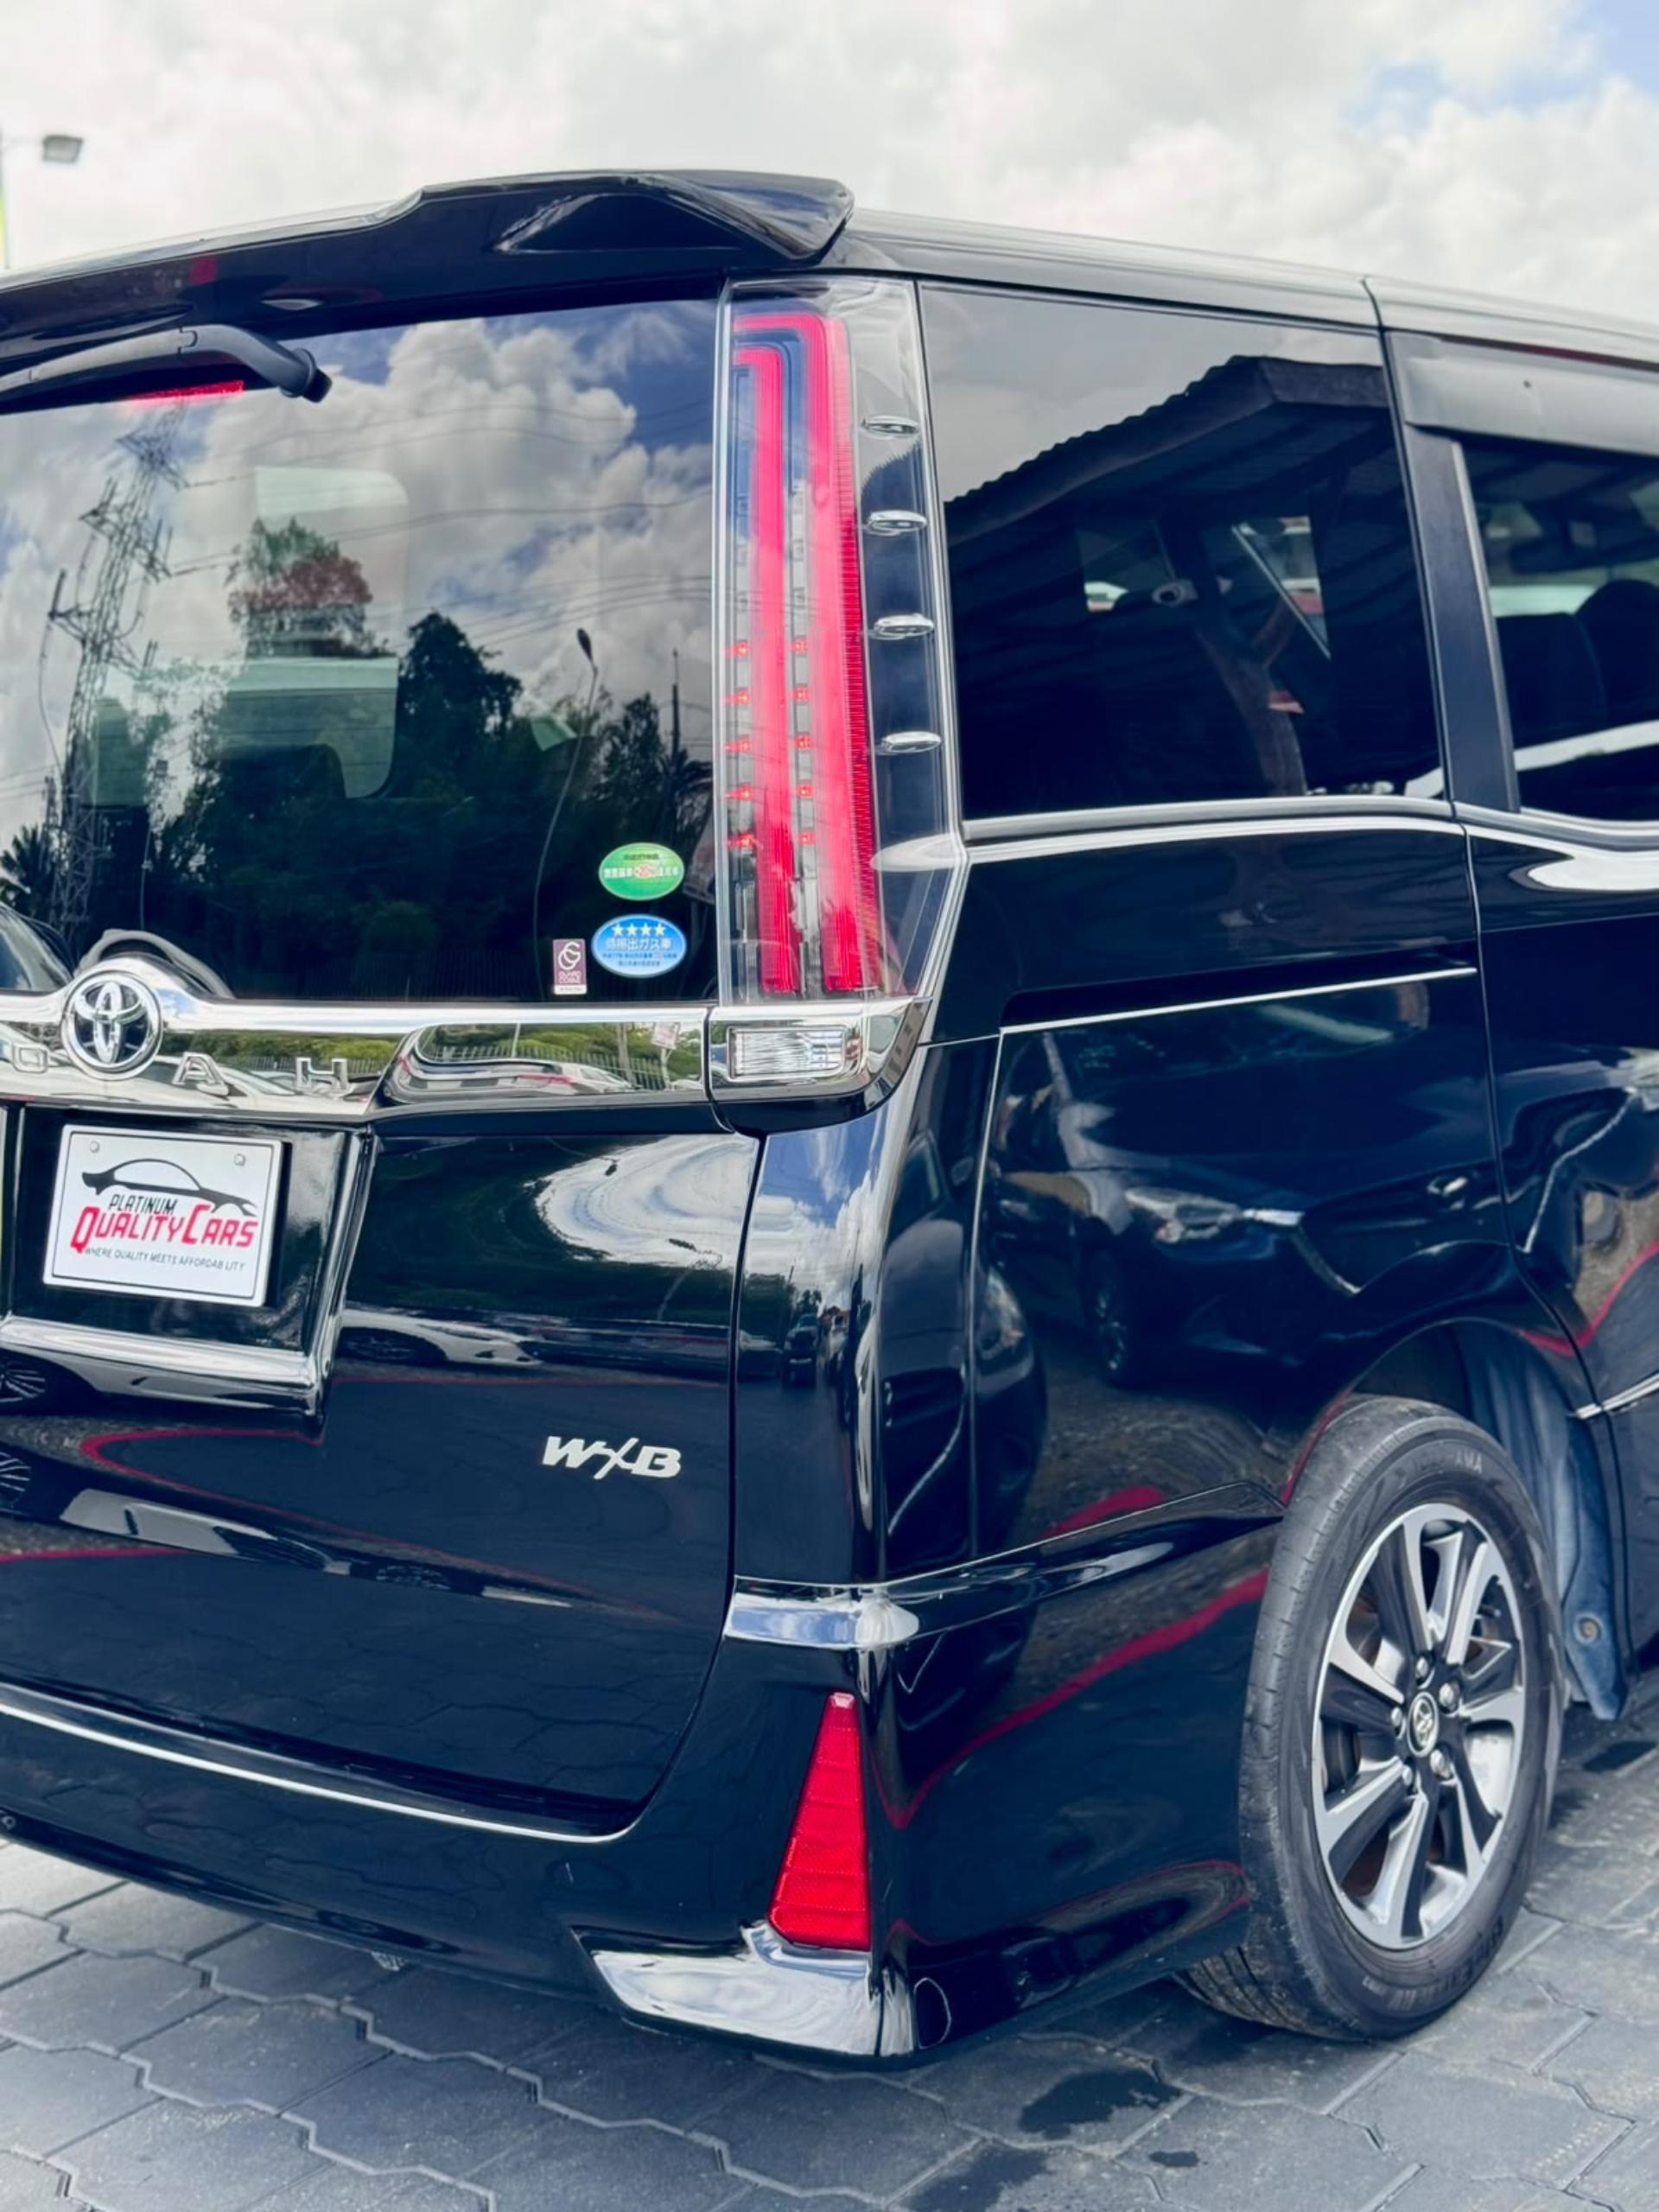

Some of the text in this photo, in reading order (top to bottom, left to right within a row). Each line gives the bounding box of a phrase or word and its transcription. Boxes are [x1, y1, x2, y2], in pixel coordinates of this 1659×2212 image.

[12, 1043, 349, 1099] OAH
[109, 1194, 178, 1215] PLATINUM
[114, 1249, 149, 1262] QUALITY
[149, 1252, 178, 1265] MEETS
[179, 1256, 245, 1272] AFFORDABLITY
